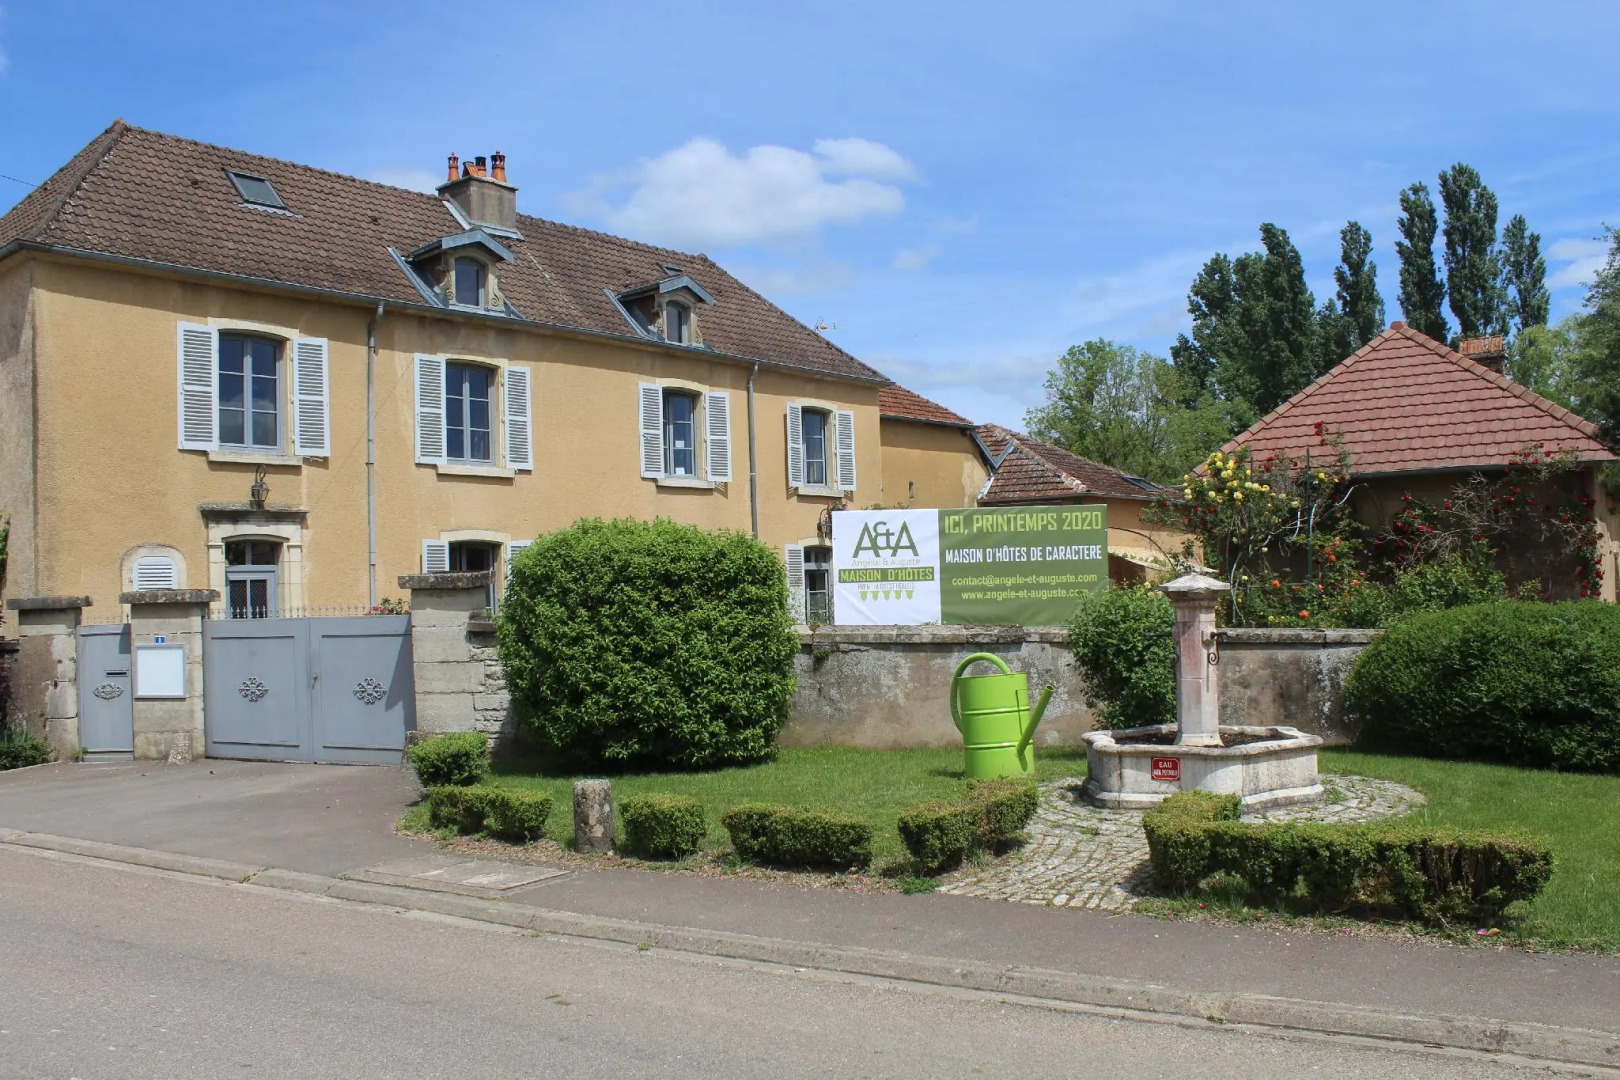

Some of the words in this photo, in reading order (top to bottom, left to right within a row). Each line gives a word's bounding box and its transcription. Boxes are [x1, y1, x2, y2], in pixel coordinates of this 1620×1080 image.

[944, 515, 968, 534] ICI,
[973, 513, 1057, 533] PRINTEMPS
[1062, 511, 1102, 530] 2020
[945, 548, 983, 563] MAISON
[986, 545, 1027, 562] D'HÔTES
[1030, 547, 1043, 561] DE
[1045, 545, 1103, 560] CARACTERE
[840, 570, 881, 582] MAISON
[887, 567, 933, 580] D'HÔTES
[952, 573, 1098, 586] contact@angele-et-auguste.com
